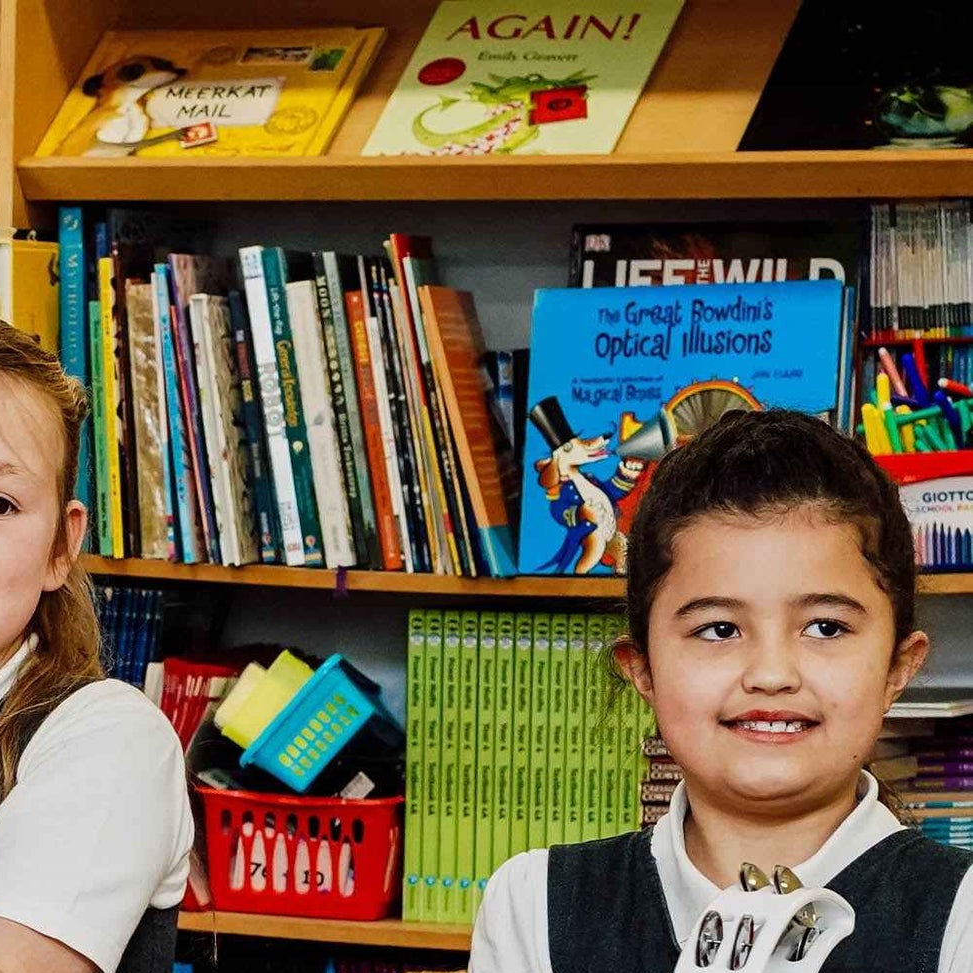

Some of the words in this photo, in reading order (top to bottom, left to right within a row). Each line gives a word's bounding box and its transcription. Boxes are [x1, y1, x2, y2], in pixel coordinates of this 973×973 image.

[445, 13, 641, 41] AGAIN!
[166, 84, 273, 100] MEERKAT
[177, 104, 232, 119] MAIL
[598, 308, 621, 326] The
[625, 301, 683, 327] Great
[595, 325, 672, 365] Optical
[682, 323, 773, 357] Illusions
